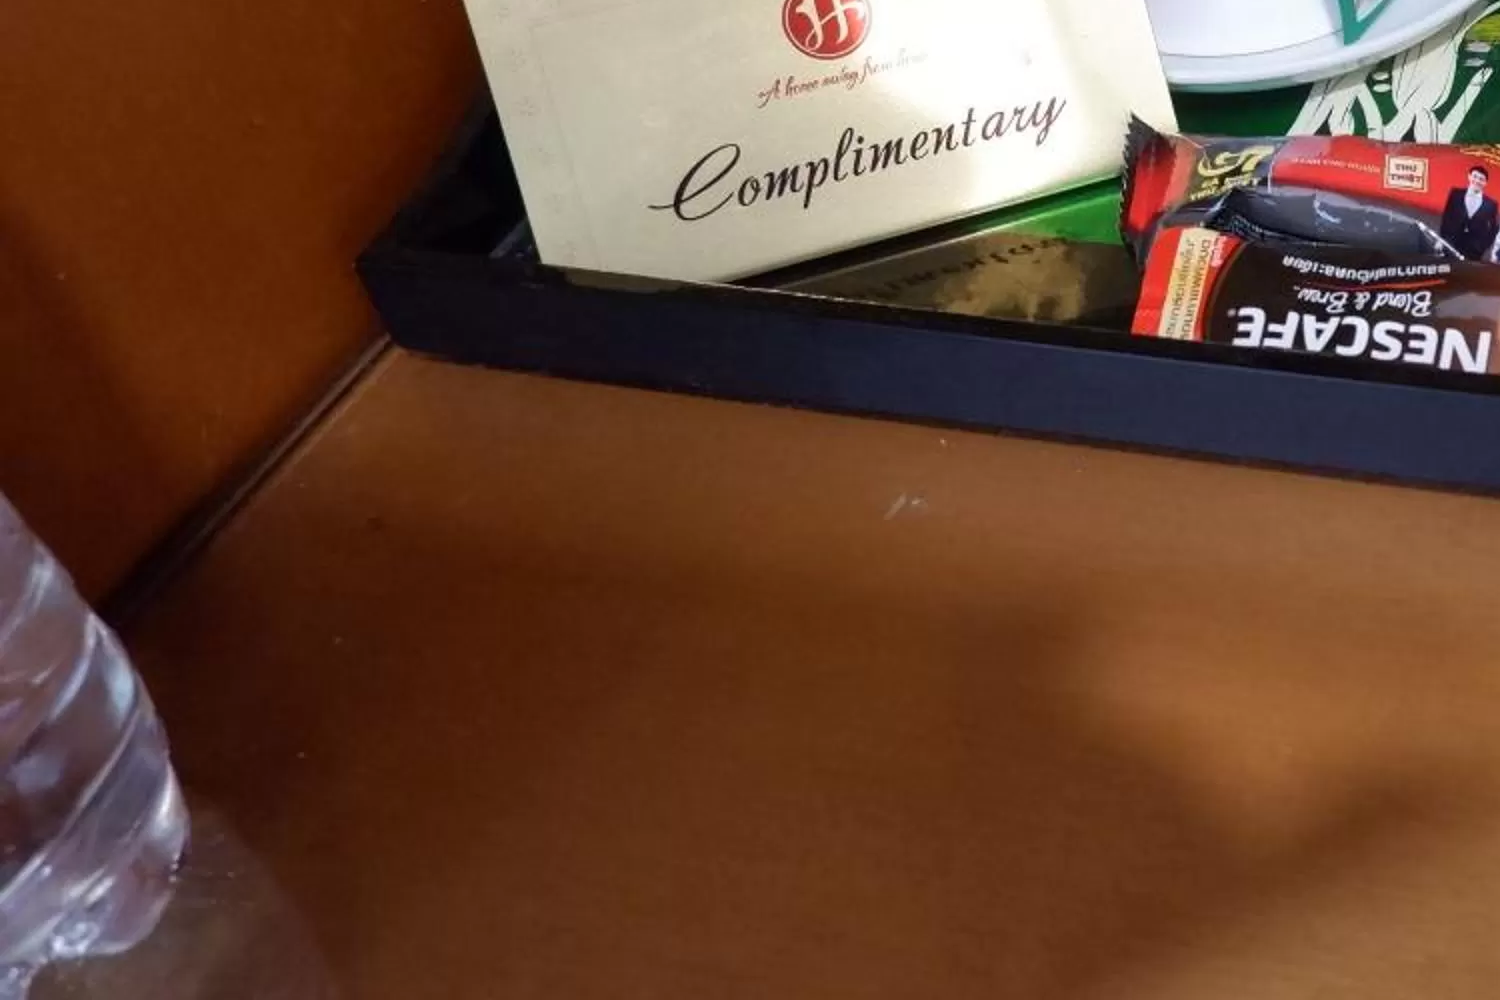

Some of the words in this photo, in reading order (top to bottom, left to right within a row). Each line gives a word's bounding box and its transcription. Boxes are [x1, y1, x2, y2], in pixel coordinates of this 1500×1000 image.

[648, 95, 1067, 221] Complimentary
[1352, 290, 1366, 311] &
[1373, 290, 1432, 317] Blend
